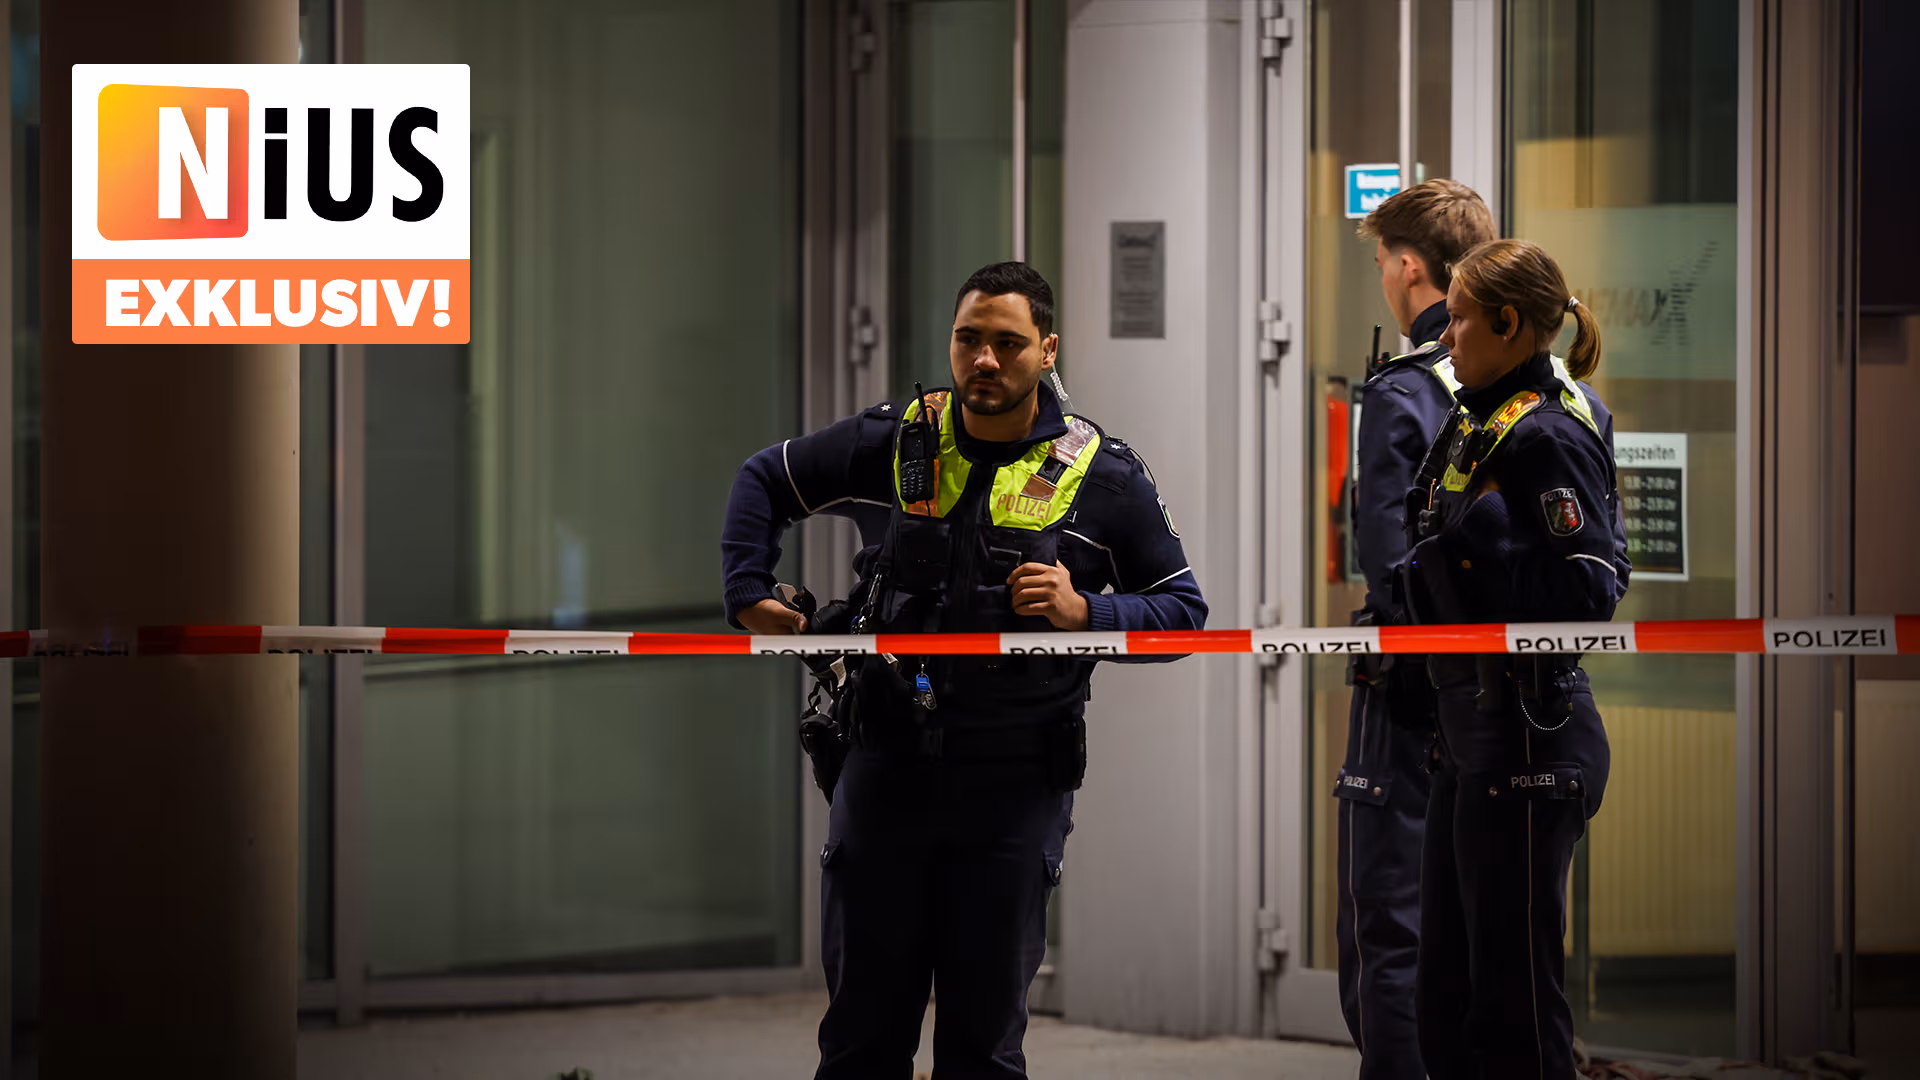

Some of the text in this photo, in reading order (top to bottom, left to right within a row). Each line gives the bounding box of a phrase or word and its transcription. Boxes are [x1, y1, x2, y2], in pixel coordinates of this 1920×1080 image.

[996, 493, 1052, 520] POLIZEI
[1516, 636, 1627, 652] POLIZEI
[1773, 629, 1886, 648] POLIZEI
[1511, 774, 1555, 788] POLIZEI
